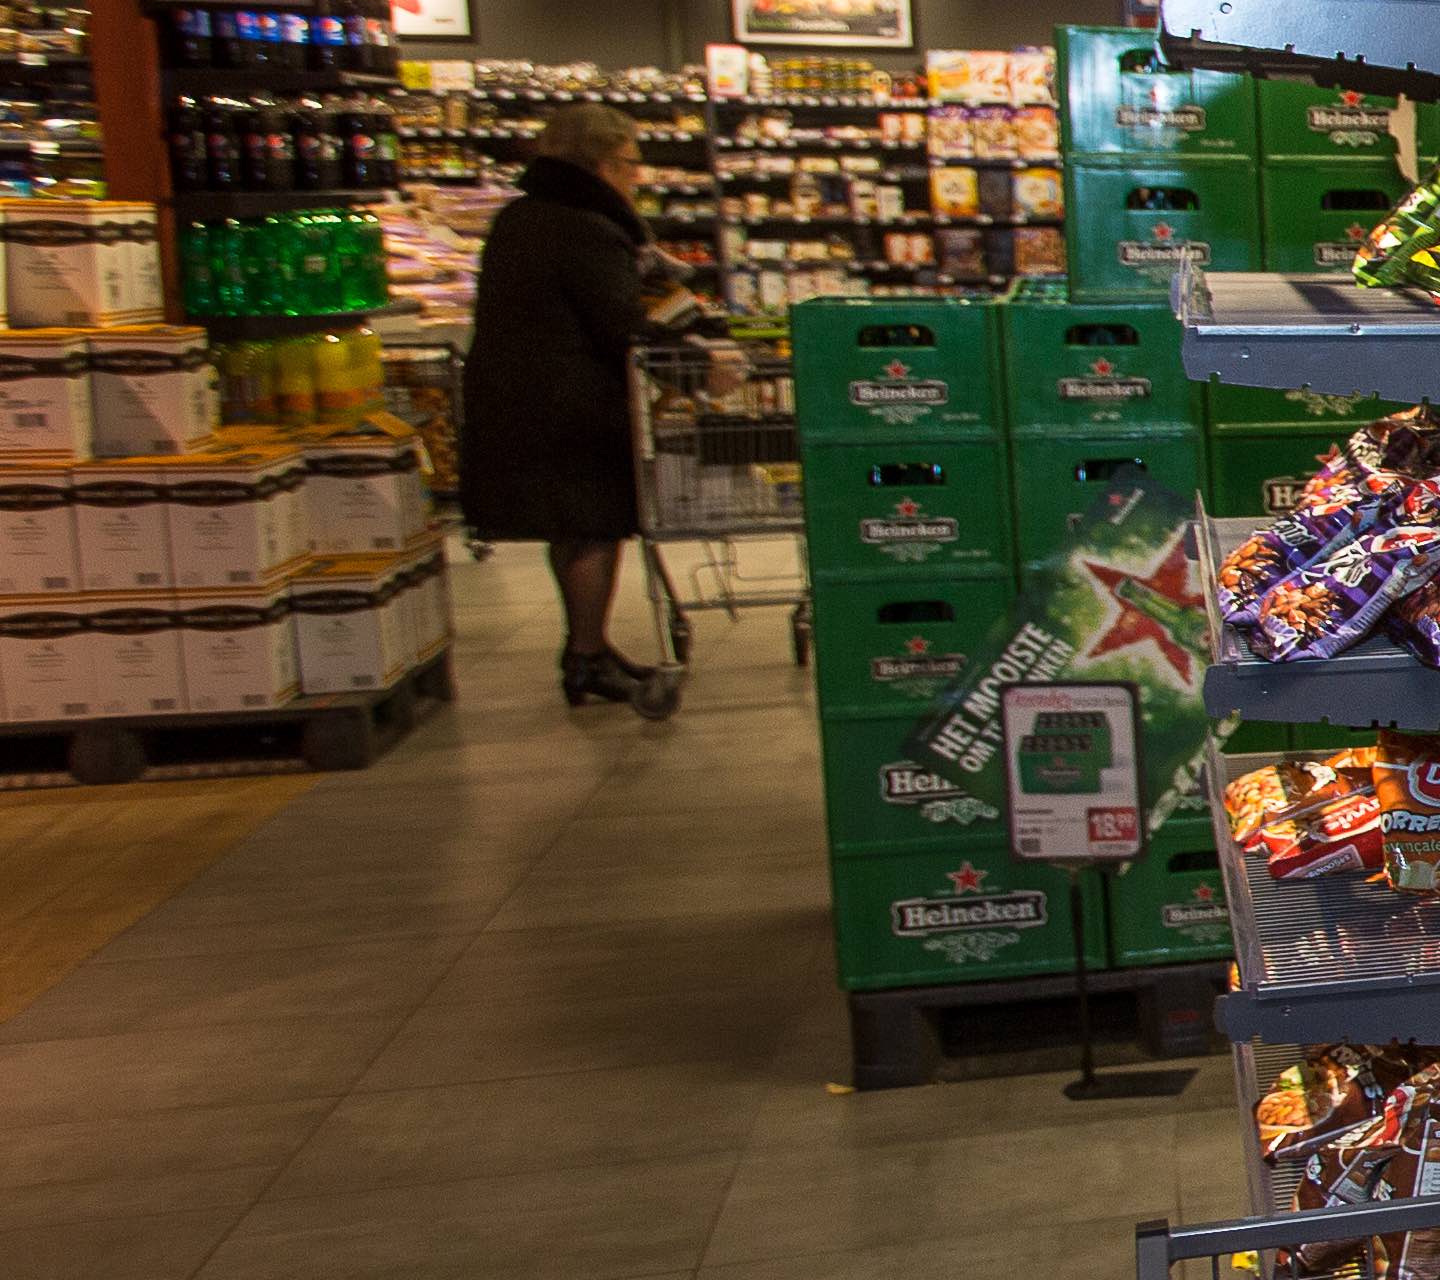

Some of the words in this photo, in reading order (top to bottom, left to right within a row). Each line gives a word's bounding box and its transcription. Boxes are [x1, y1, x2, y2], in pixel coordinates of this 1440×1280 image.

[1312, 111, 1391, 129] Heineke
[927, 700, 982, 761] HET
[975, 620, 1054, 721] MOOISTE
[957, 738, 997, 773] OM
[901, 897, 1039, 930] Heineken
